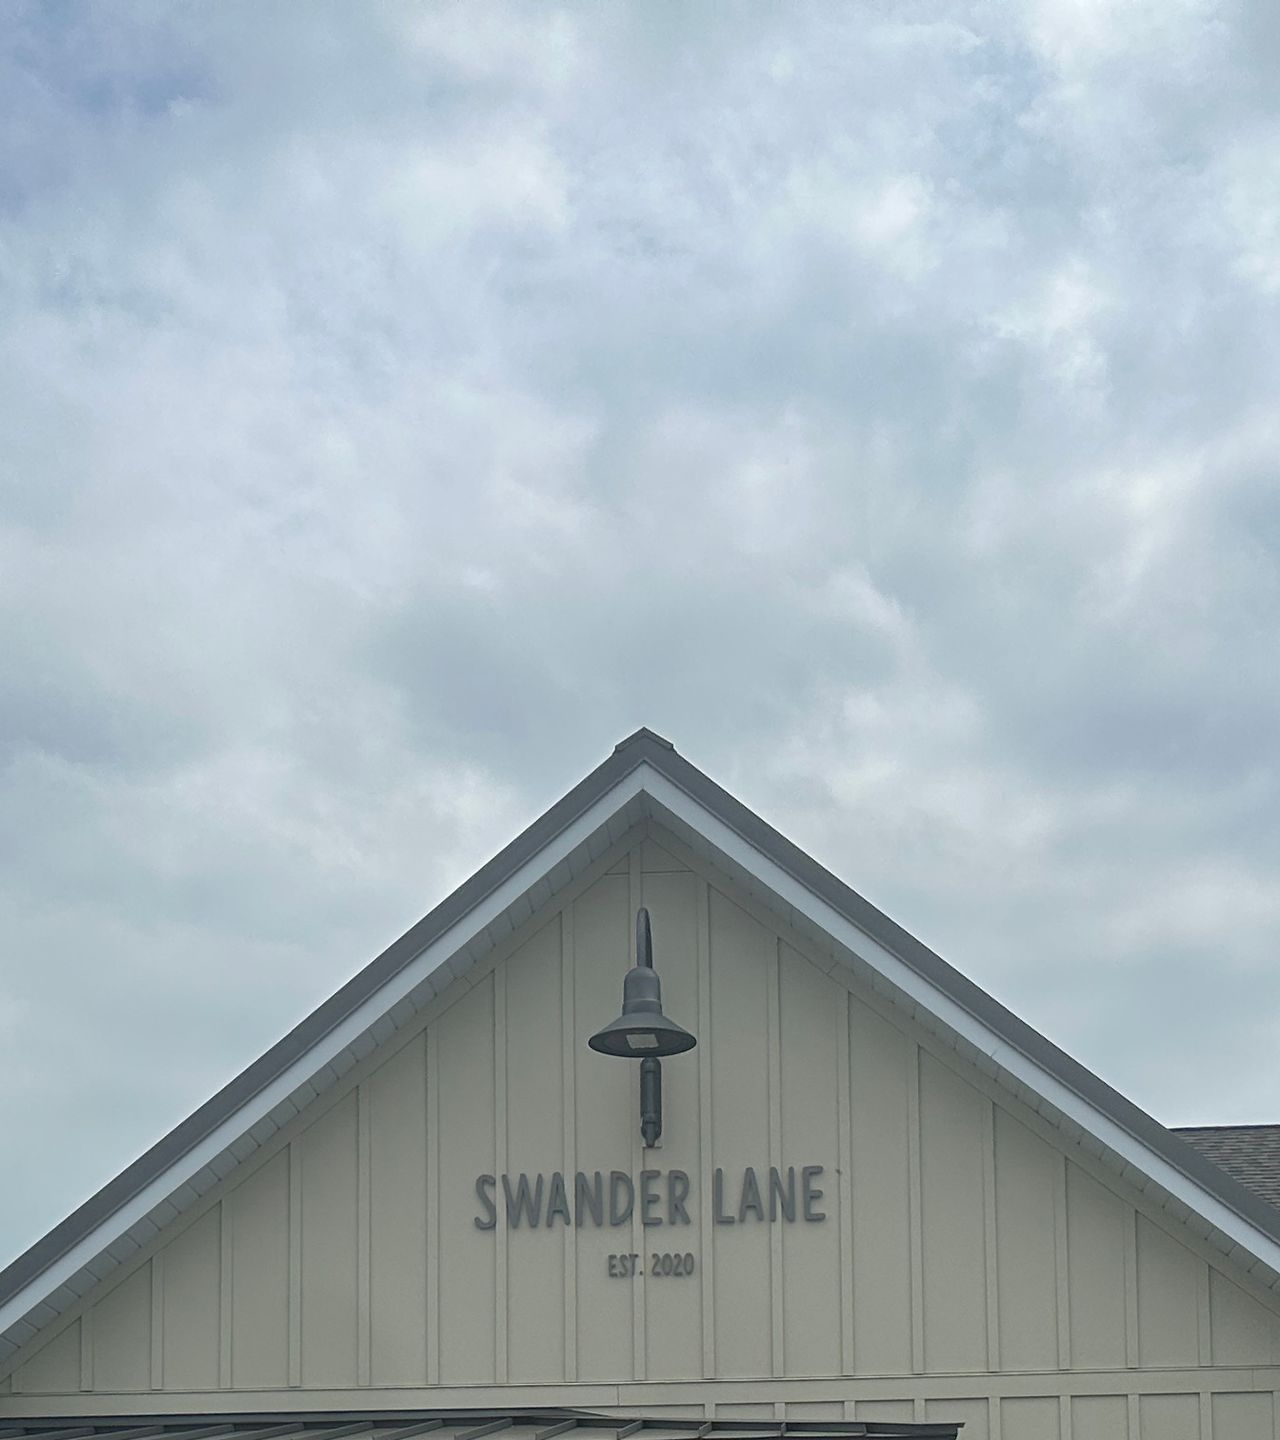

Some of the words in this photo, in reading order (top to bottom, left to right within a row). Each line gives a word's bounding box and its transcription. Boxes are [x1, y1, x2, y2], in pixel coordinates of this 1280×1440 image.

[474, 1170, 691, 1230] SWANDER
[715, 1165, 826, 1225] LANE
[608, 1254, 644, 1277] EST.
[651, 1253, 694, 1276] 2020
